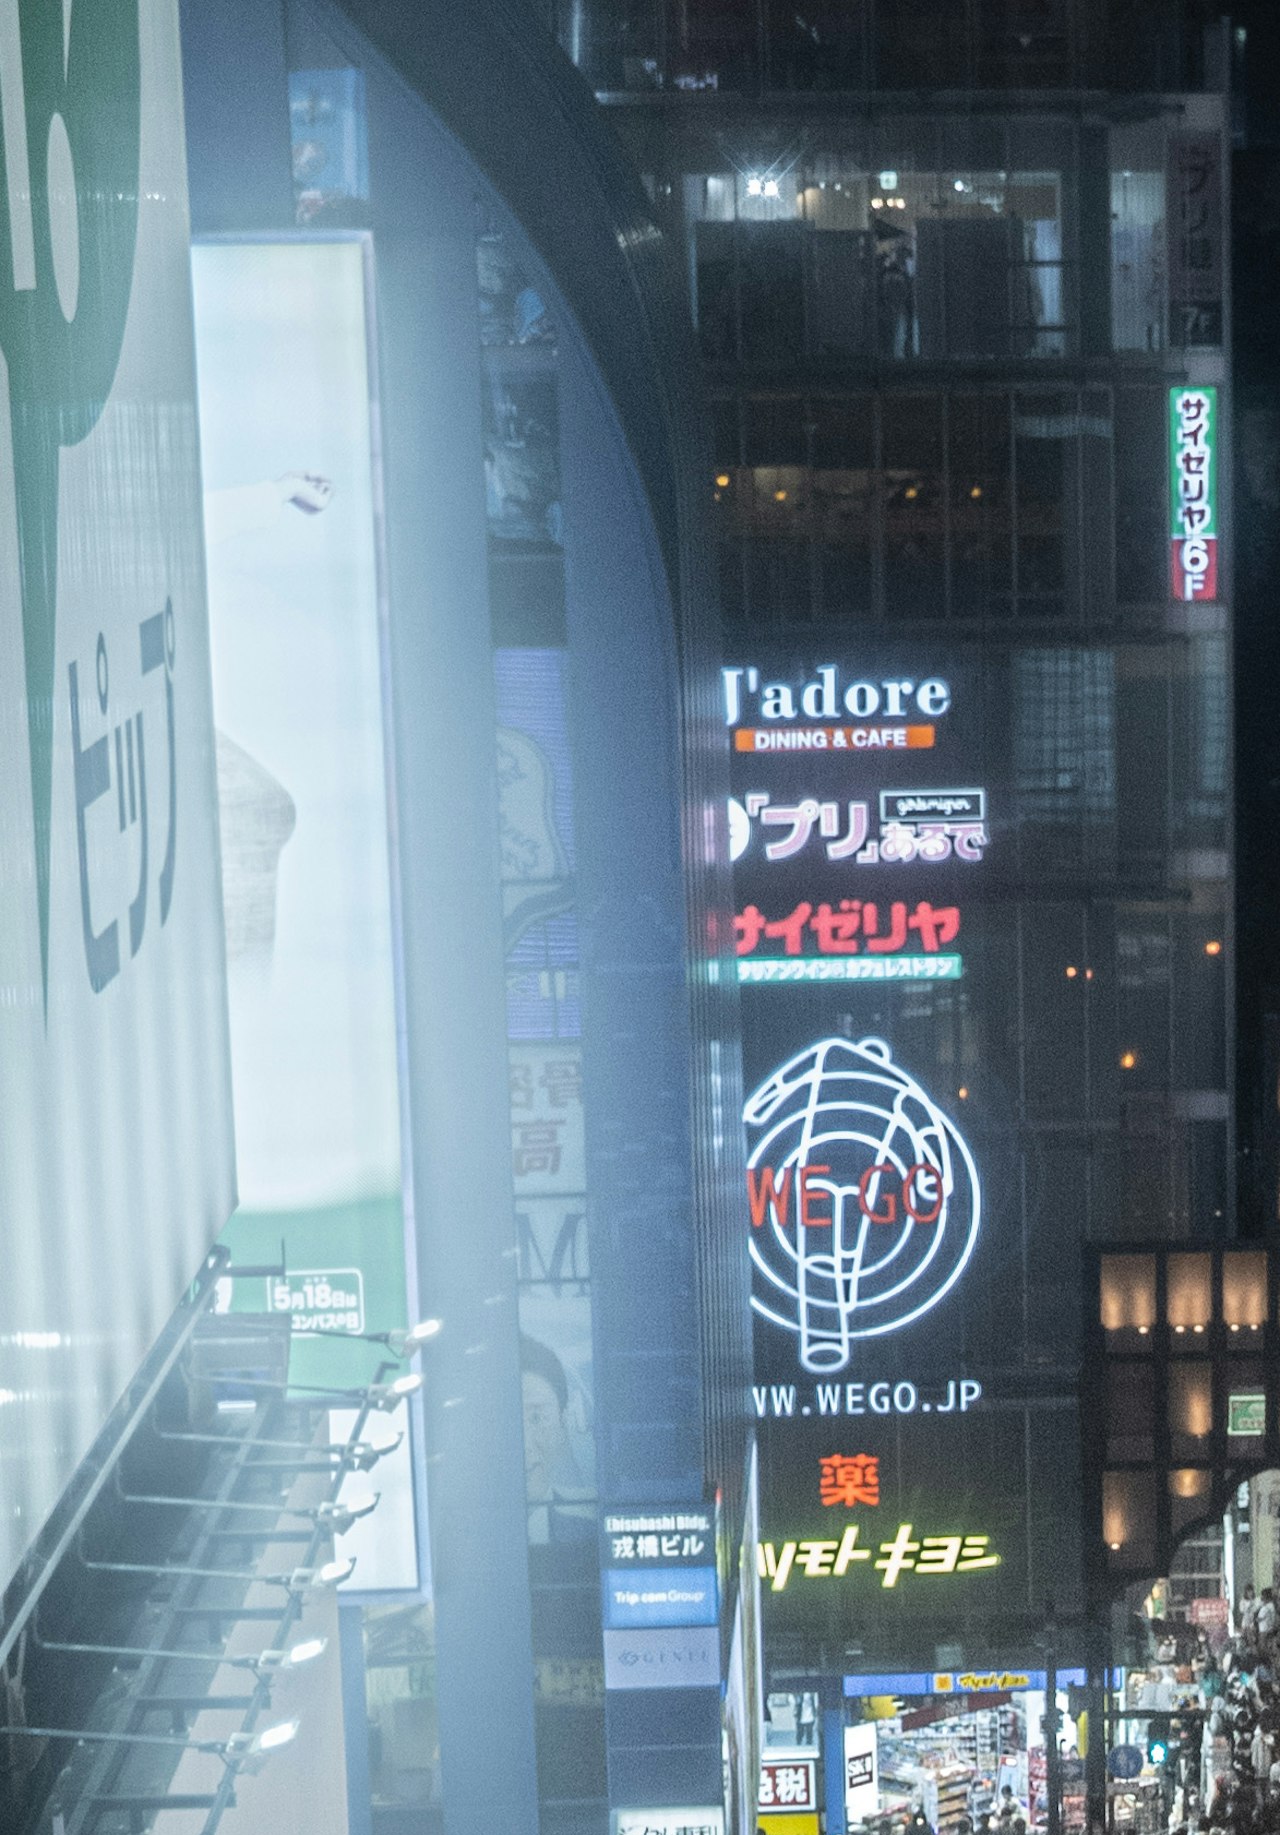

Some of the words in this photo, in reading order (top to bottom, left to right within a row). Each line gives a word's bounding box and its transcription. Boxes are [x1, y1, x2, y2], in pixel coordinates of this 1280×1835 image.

[1183, 539, 1209, 600] 6F
[721, 665, 950, 726] J'adore
[755, 729, 827, 749] DINING
[832, 729, 847, 748] &
[852, 728, 907, 748] CAFE
[68, 595, 176, 994] ピップ
[819, 1453, 881, 1508] 薬
[613, 1536, 705, 1558] 戎橋ビル
